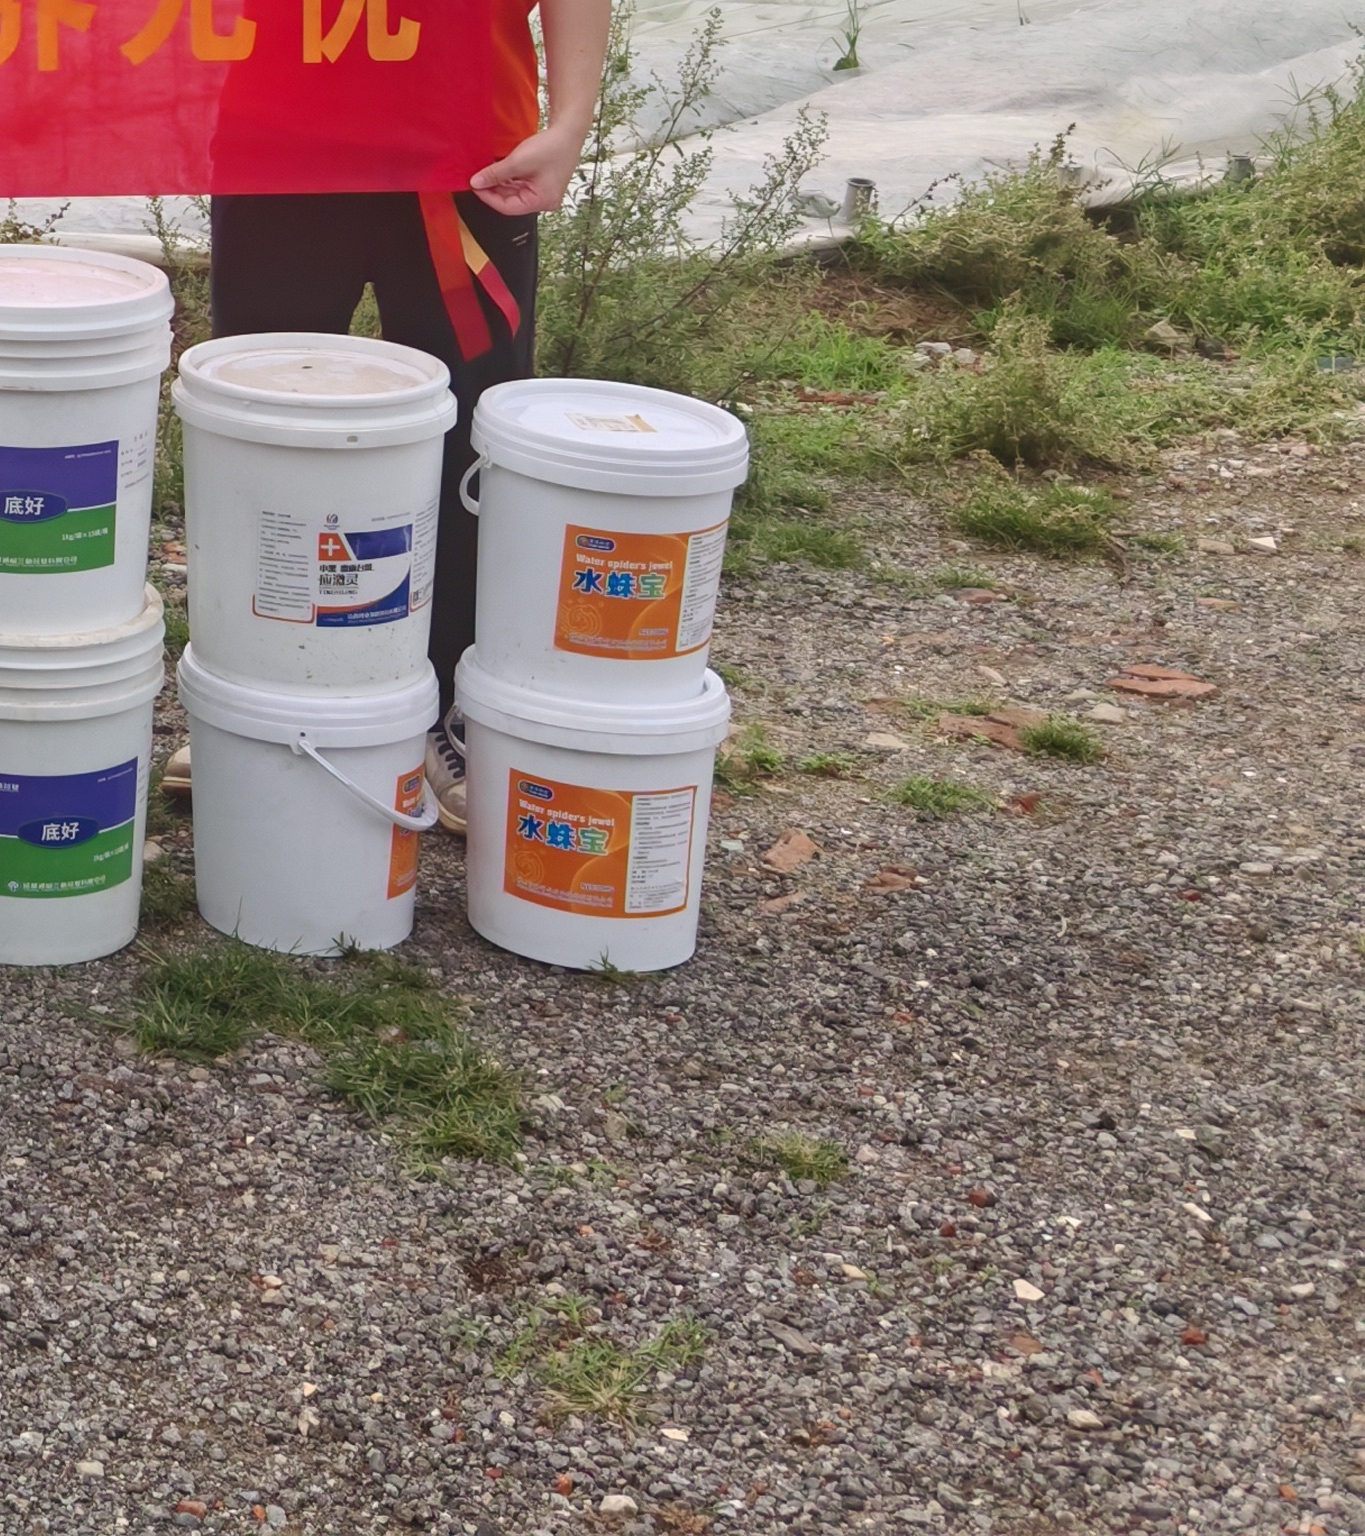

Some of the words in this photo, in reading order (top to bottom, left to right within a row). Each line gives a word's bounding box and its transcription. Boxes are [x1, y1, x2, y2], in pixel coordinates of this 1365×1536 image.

[4, 496, 45, 516] 底好
[576, 553, 605, 567] Water
[648, 561, 673, 572] jewel
[572, 567, 667, 600] 水蛛宝
[519, 799, 545, 815] Water
[587, 814, 615, 827] jewel
[41, 821, 80, 842] 底好
[516, 813, 609, 857] 水蛛宝
